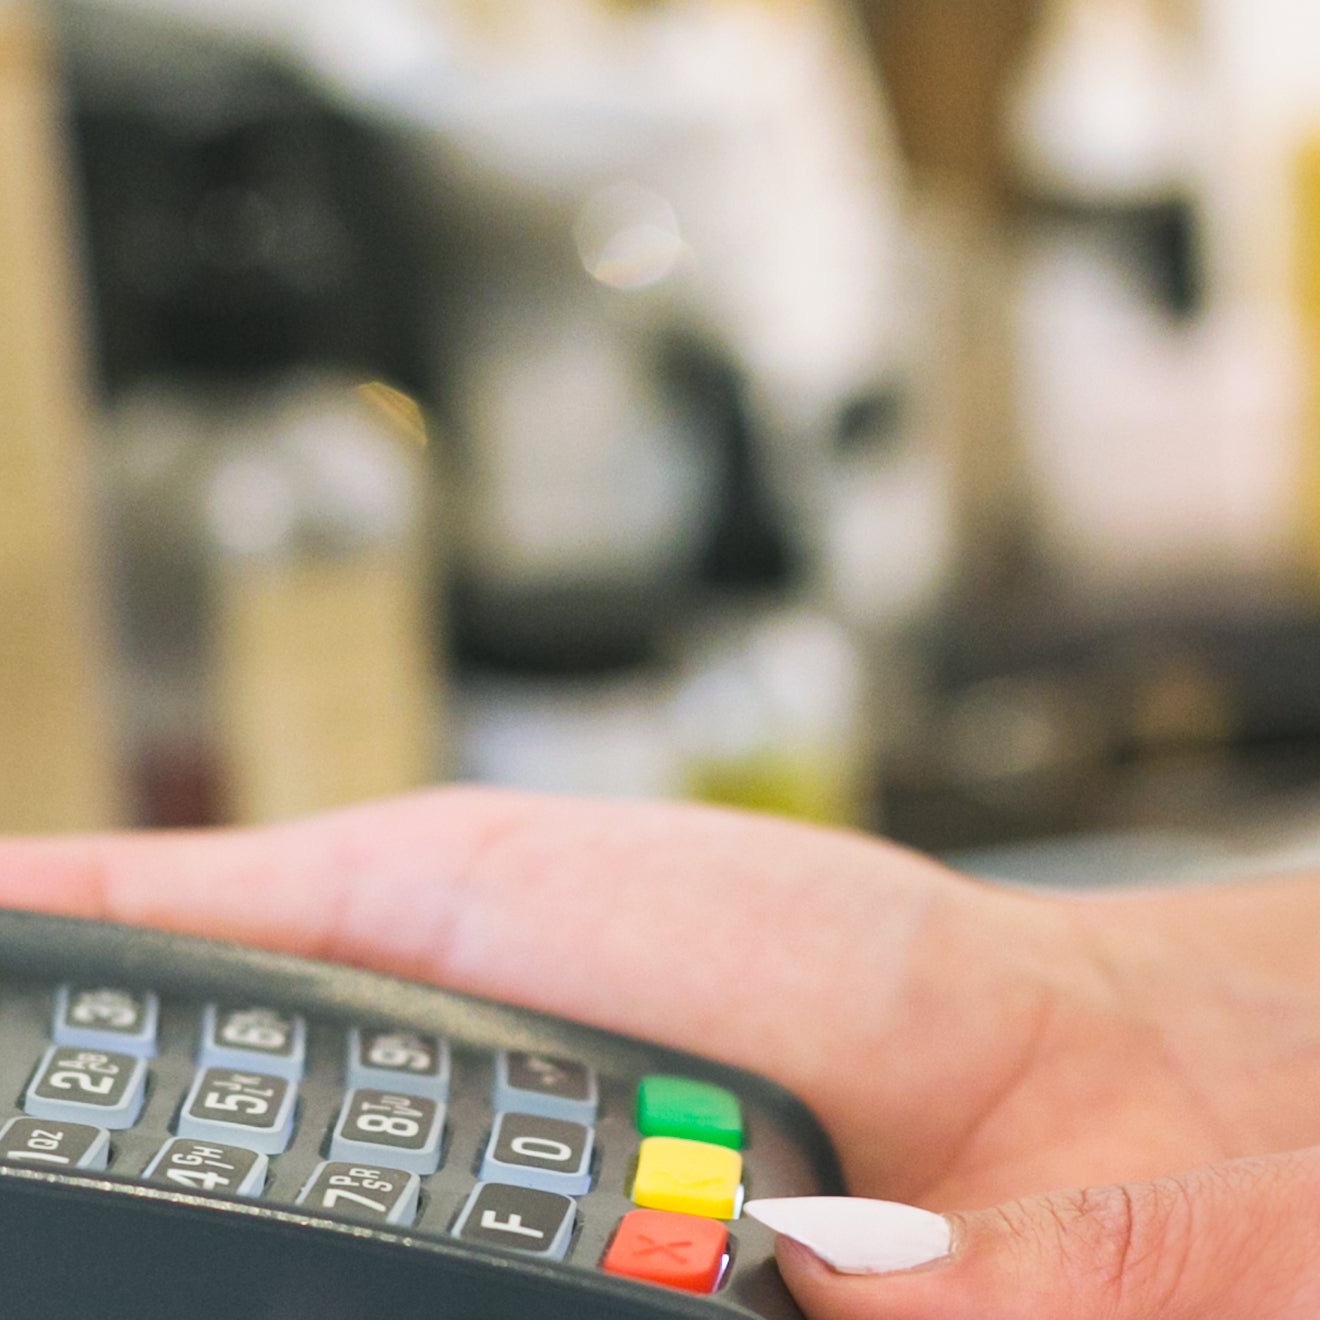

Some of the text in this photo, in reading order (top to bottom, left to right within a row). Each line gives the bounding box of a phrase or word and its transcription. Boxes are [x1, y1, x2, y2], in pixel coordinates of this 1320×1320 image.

[49, 1070, 115, 1094] 2
[204, 1091, 269, 1115] 5
[356, 1113, 420, 1137] 8
[166, 1168, 230, 1191] 4
[322, 1188, 388, 1213] 7
[481, 1209, 545, 1239] F
